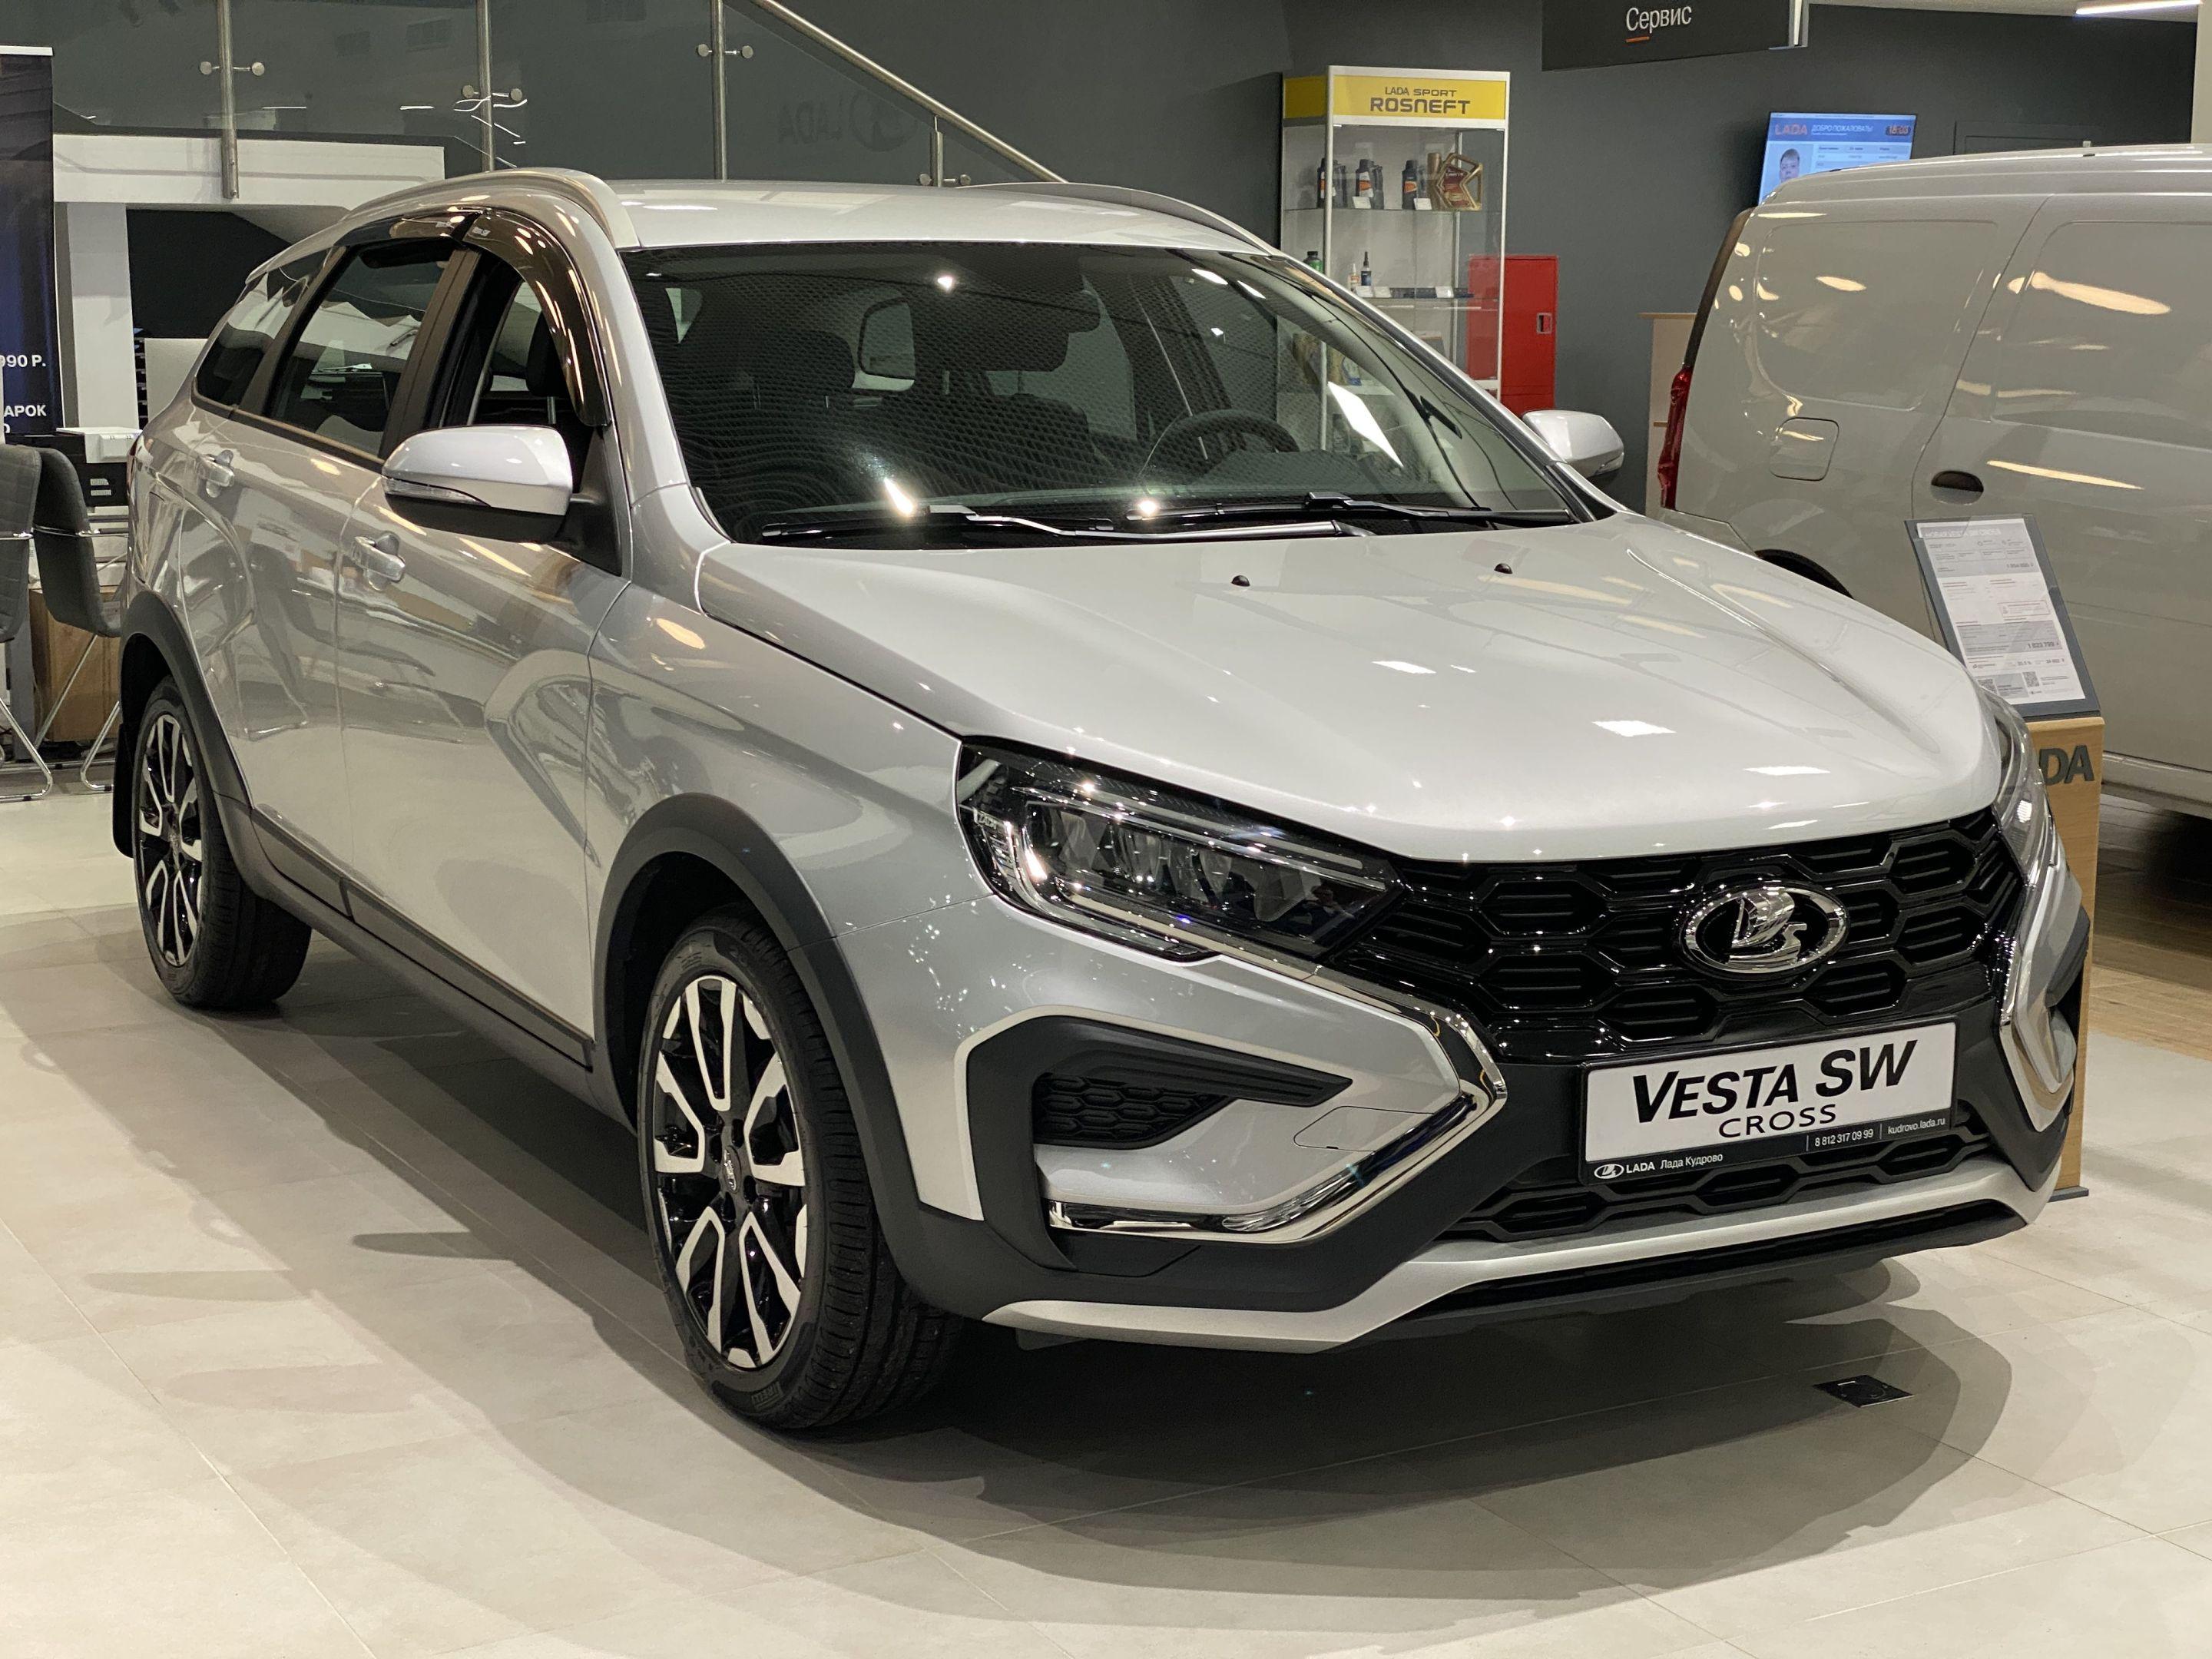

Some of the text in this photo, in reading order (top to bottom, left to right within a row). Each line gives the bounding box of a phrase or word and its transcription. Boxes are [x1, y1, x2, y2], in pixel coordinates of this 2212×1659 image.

[1626, 6, 1692, 34] Сервис
[1385, 87, 1457, 97] LADA SPORT
[1370, 97, 1471, 114] ROSNEFT
[1775, 124, 1807, 135] LADA
[2039, 745, 2095, 786] DA
[1633, 1039, 1919, 1123] VESTA SW
[1718, 1104, 1836, 1138] CROSS
[1888, 1118, 1945, 1134] kudrovo.lada.ru
[1815, 1128, 1873, 1147] 8 812 317 09 99
[1626, 1161, 1655, 1174] LADA
[1660, 1154, 1723, 1170] Лада Кудрово
